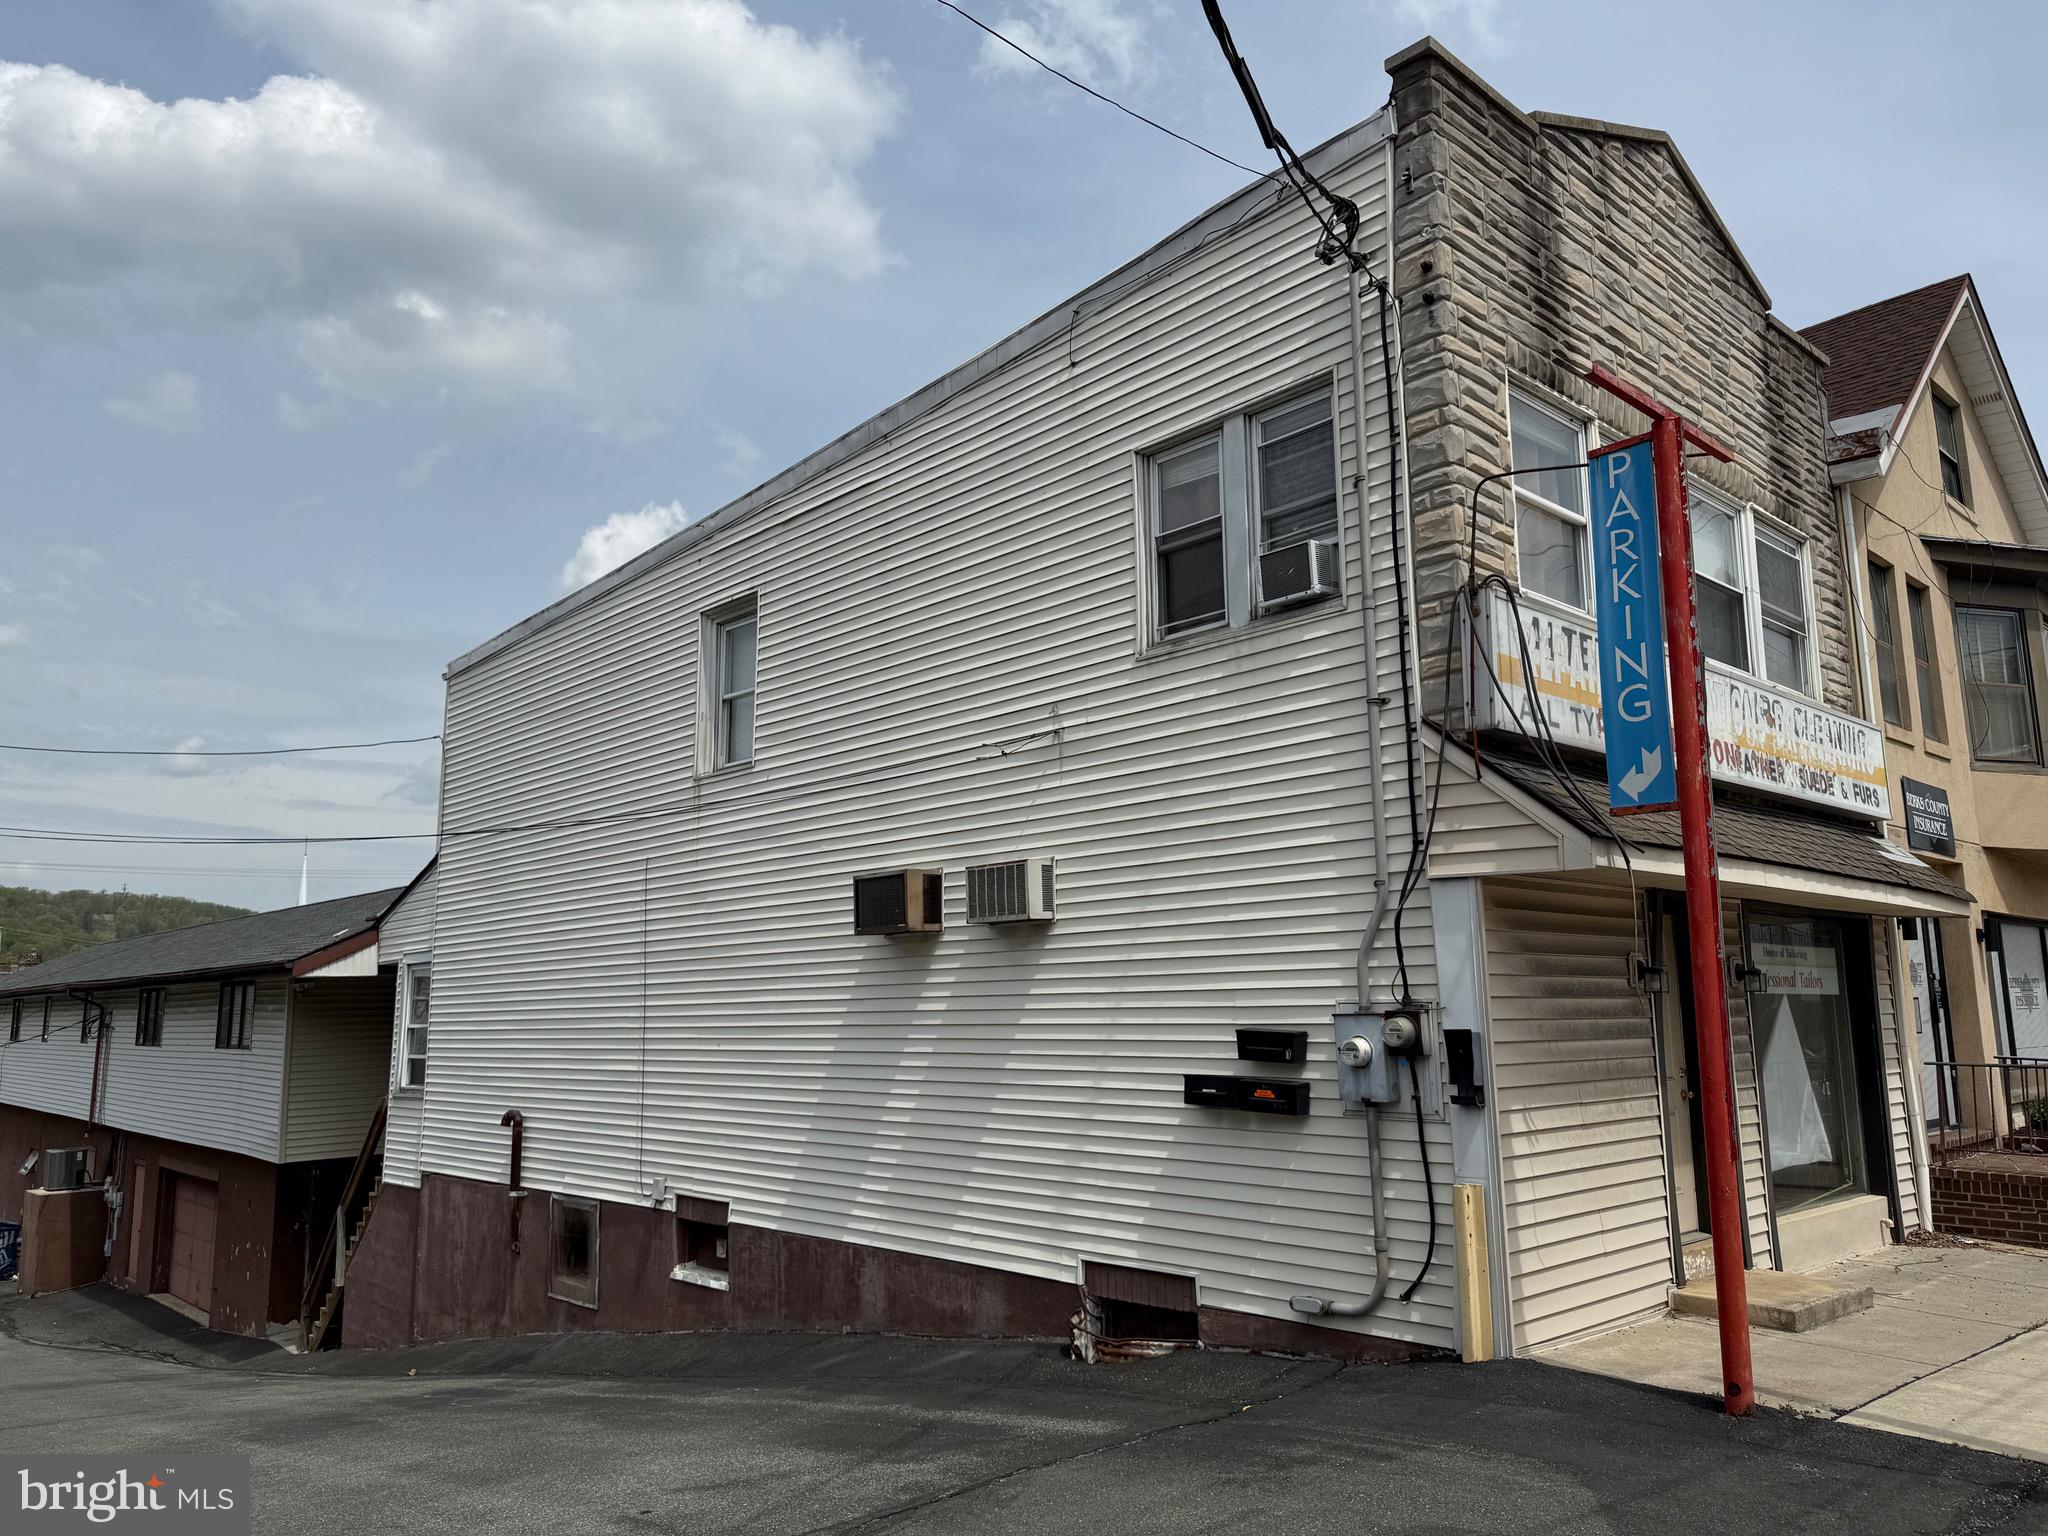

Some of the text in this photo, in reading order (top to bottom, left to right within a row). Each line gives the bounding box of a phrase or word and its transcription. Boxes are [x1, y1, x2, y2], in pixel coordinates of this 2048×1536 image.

[1606, 452, 1652, 723] PARKING
[1840, 781, 1850, 801] &
[1852, 782, 1881, 809] FURS
[1905, 792, 1950, 817] BERKS COUNTY
[1913, 815, 1948, 836] INSURANCE
[1766, 970, 1824, 989] essional Tailors
